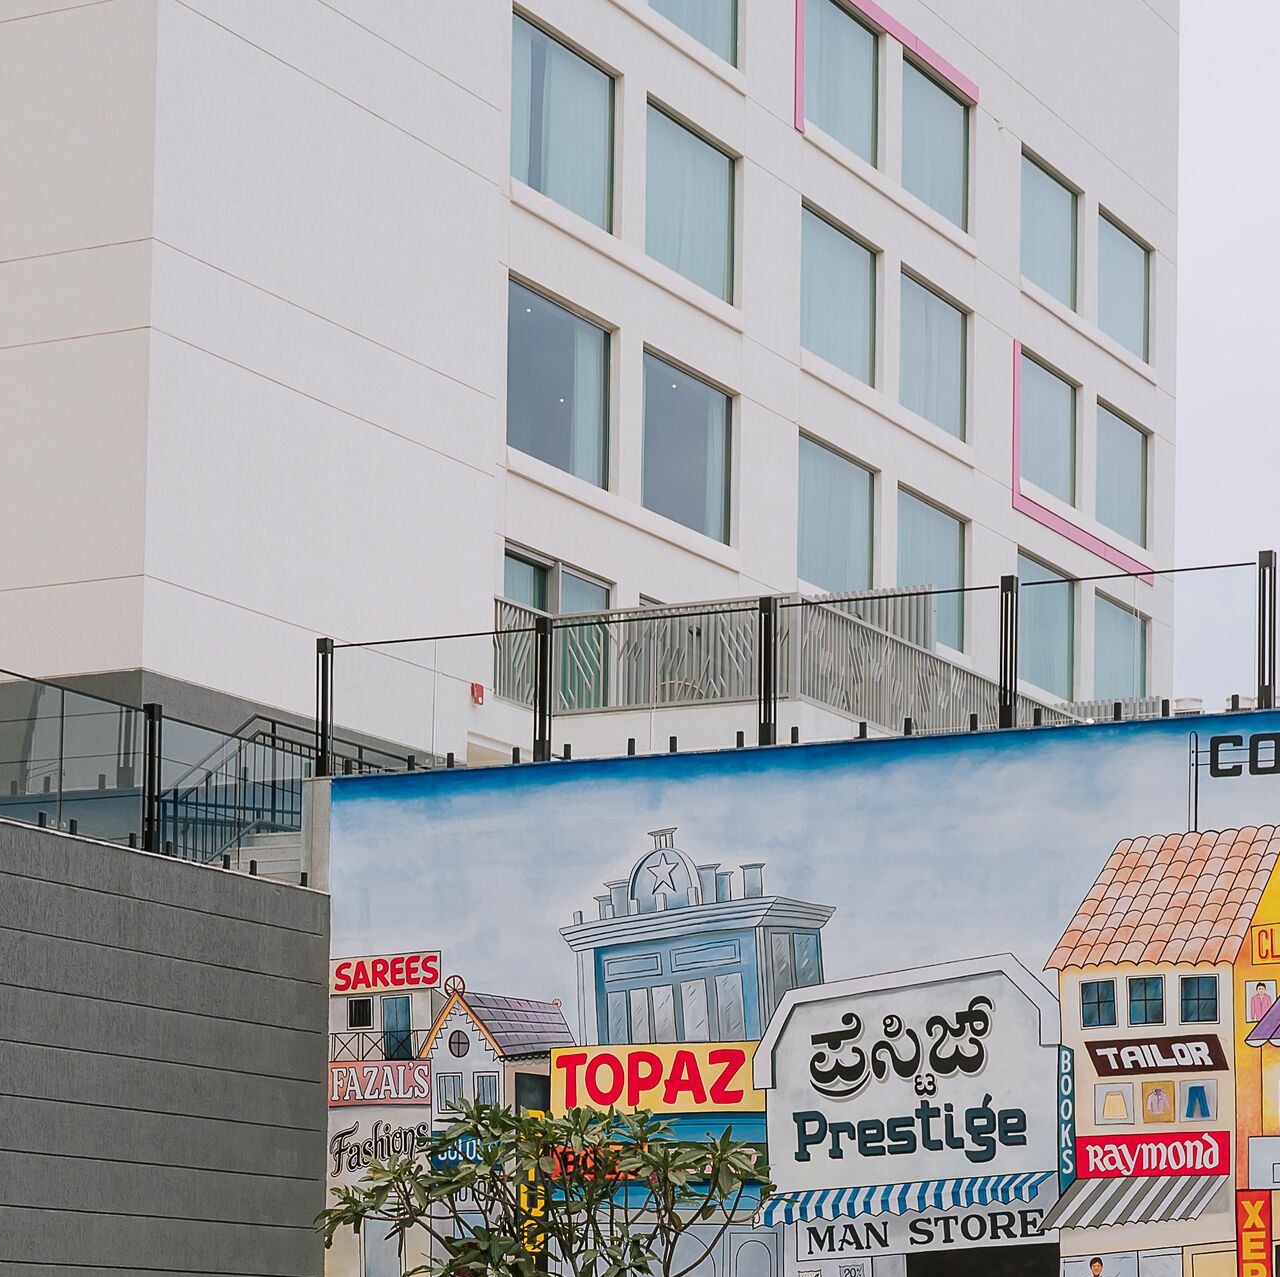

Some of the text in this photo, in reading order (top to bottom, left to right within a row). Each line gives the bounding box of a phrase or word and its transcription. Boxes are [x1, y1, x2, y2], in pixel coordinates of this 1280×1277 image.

[334, 954, 440, 992] SAREES
[555, 1048, 746, 1110] TOPAZ
[1096, 1041, 1213, 1070] TAILOR
[330, 1061, 430, 1101] FAZAL'S
[792, 1092, 1028, 1164] Prestige
[1059, 1050, 1073, 1176] BOOKS
[330, 1119, 429, 1178] Fashions
[1086, 1133, 1220, 1181] Raymond
[806, 1208, 1045, 1255] MAN STORE
